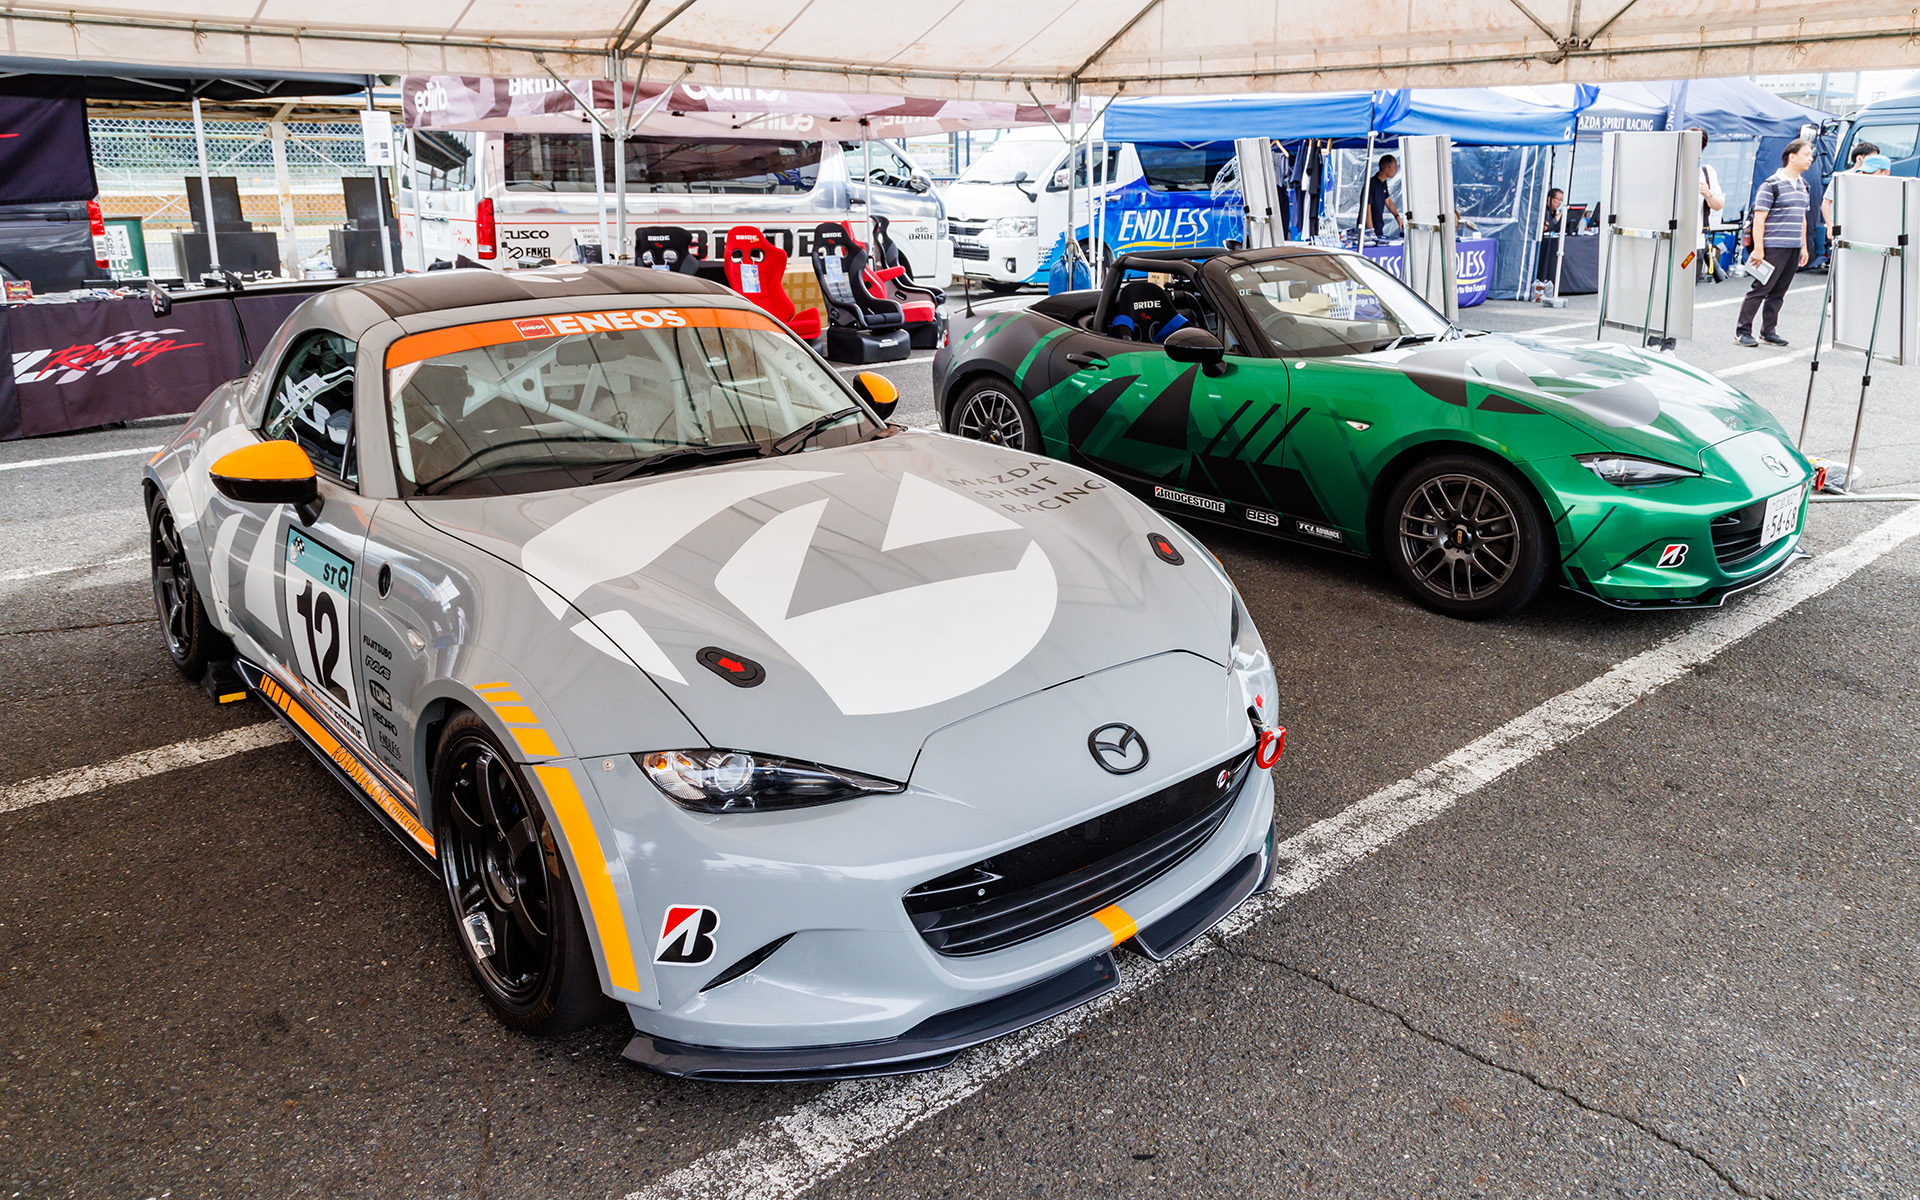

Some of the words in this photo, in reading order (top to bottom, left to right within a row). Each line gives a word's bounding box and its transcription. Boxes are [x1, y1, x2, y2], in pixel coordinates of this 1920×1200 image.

[1602, 117, 1625, 130] SPIRIT
[1626, 119, 1654, 131] RACING
[1118, 207, 1211, 241] ENDLESS
[1133, 300, 1161, 310] BRIDE
[520, 324, 546, 332] ENEOS
[549, 310, 687, 334] ENEOS
[34, 339, 204, 380] Racing
[947, 461, 1050, 487] MAZDA
[975, 476, 1058, 499] SPIRIT
[1001, 479, 1107, 513] RACING
[1155, 486, 1225, 513] BRIDGESTONE
[1247, 509, 1278, 526] BBS
[1770, 506, 1797, 538] 54-68
[296, 579, 351, 710] 12
[363, 635, 392, 660] FUJITSUBO
[365, 654, 392, 681] RAYS
[370, 682, 391, 708] TONE
[331, 746, 374, 790] ROADSTER
[387, 800, 422, 836] concept
